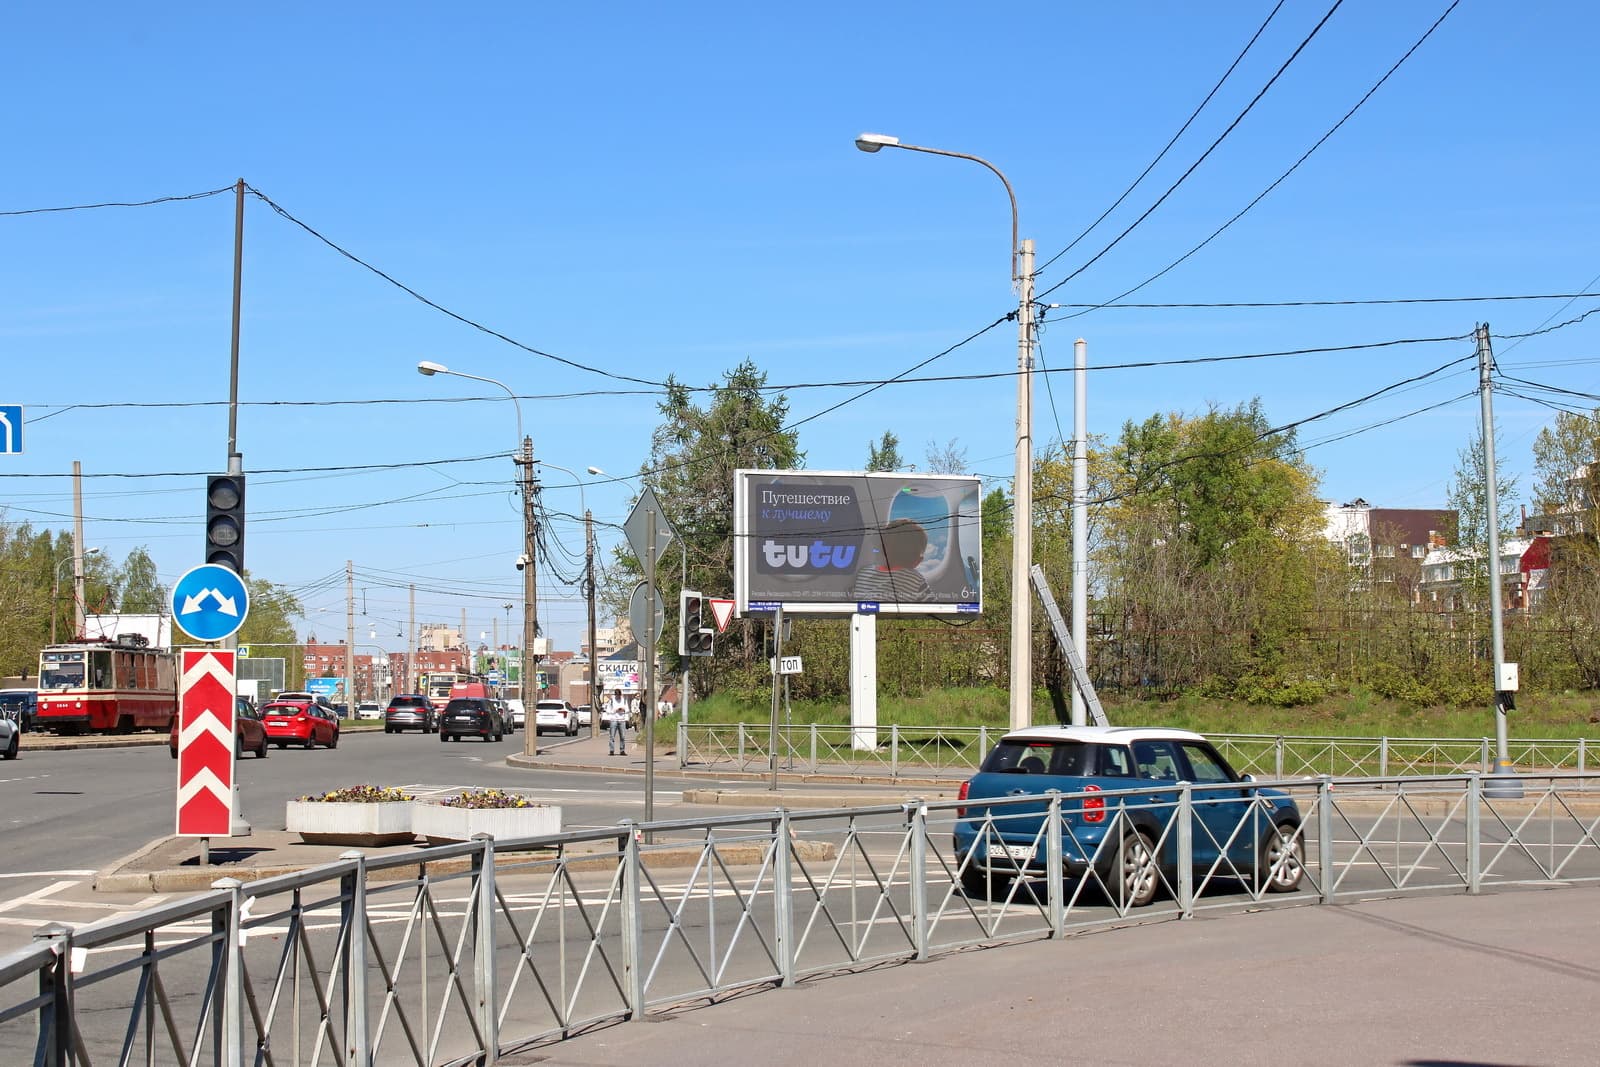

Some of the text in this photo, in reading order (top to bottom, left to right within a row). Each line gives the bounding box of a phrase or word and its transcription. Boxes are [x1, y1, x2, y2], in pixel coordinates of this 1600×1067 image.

[762, 490, 850, 506] Путешествие
[762, 509, 832, 523] к лучшему
[762, 540, 856, 569] tutu
[961, 586, 977, 598] 6+
[598, 664, 638, 673] СКИДК
[776, 659, 798, 671] ТОП
